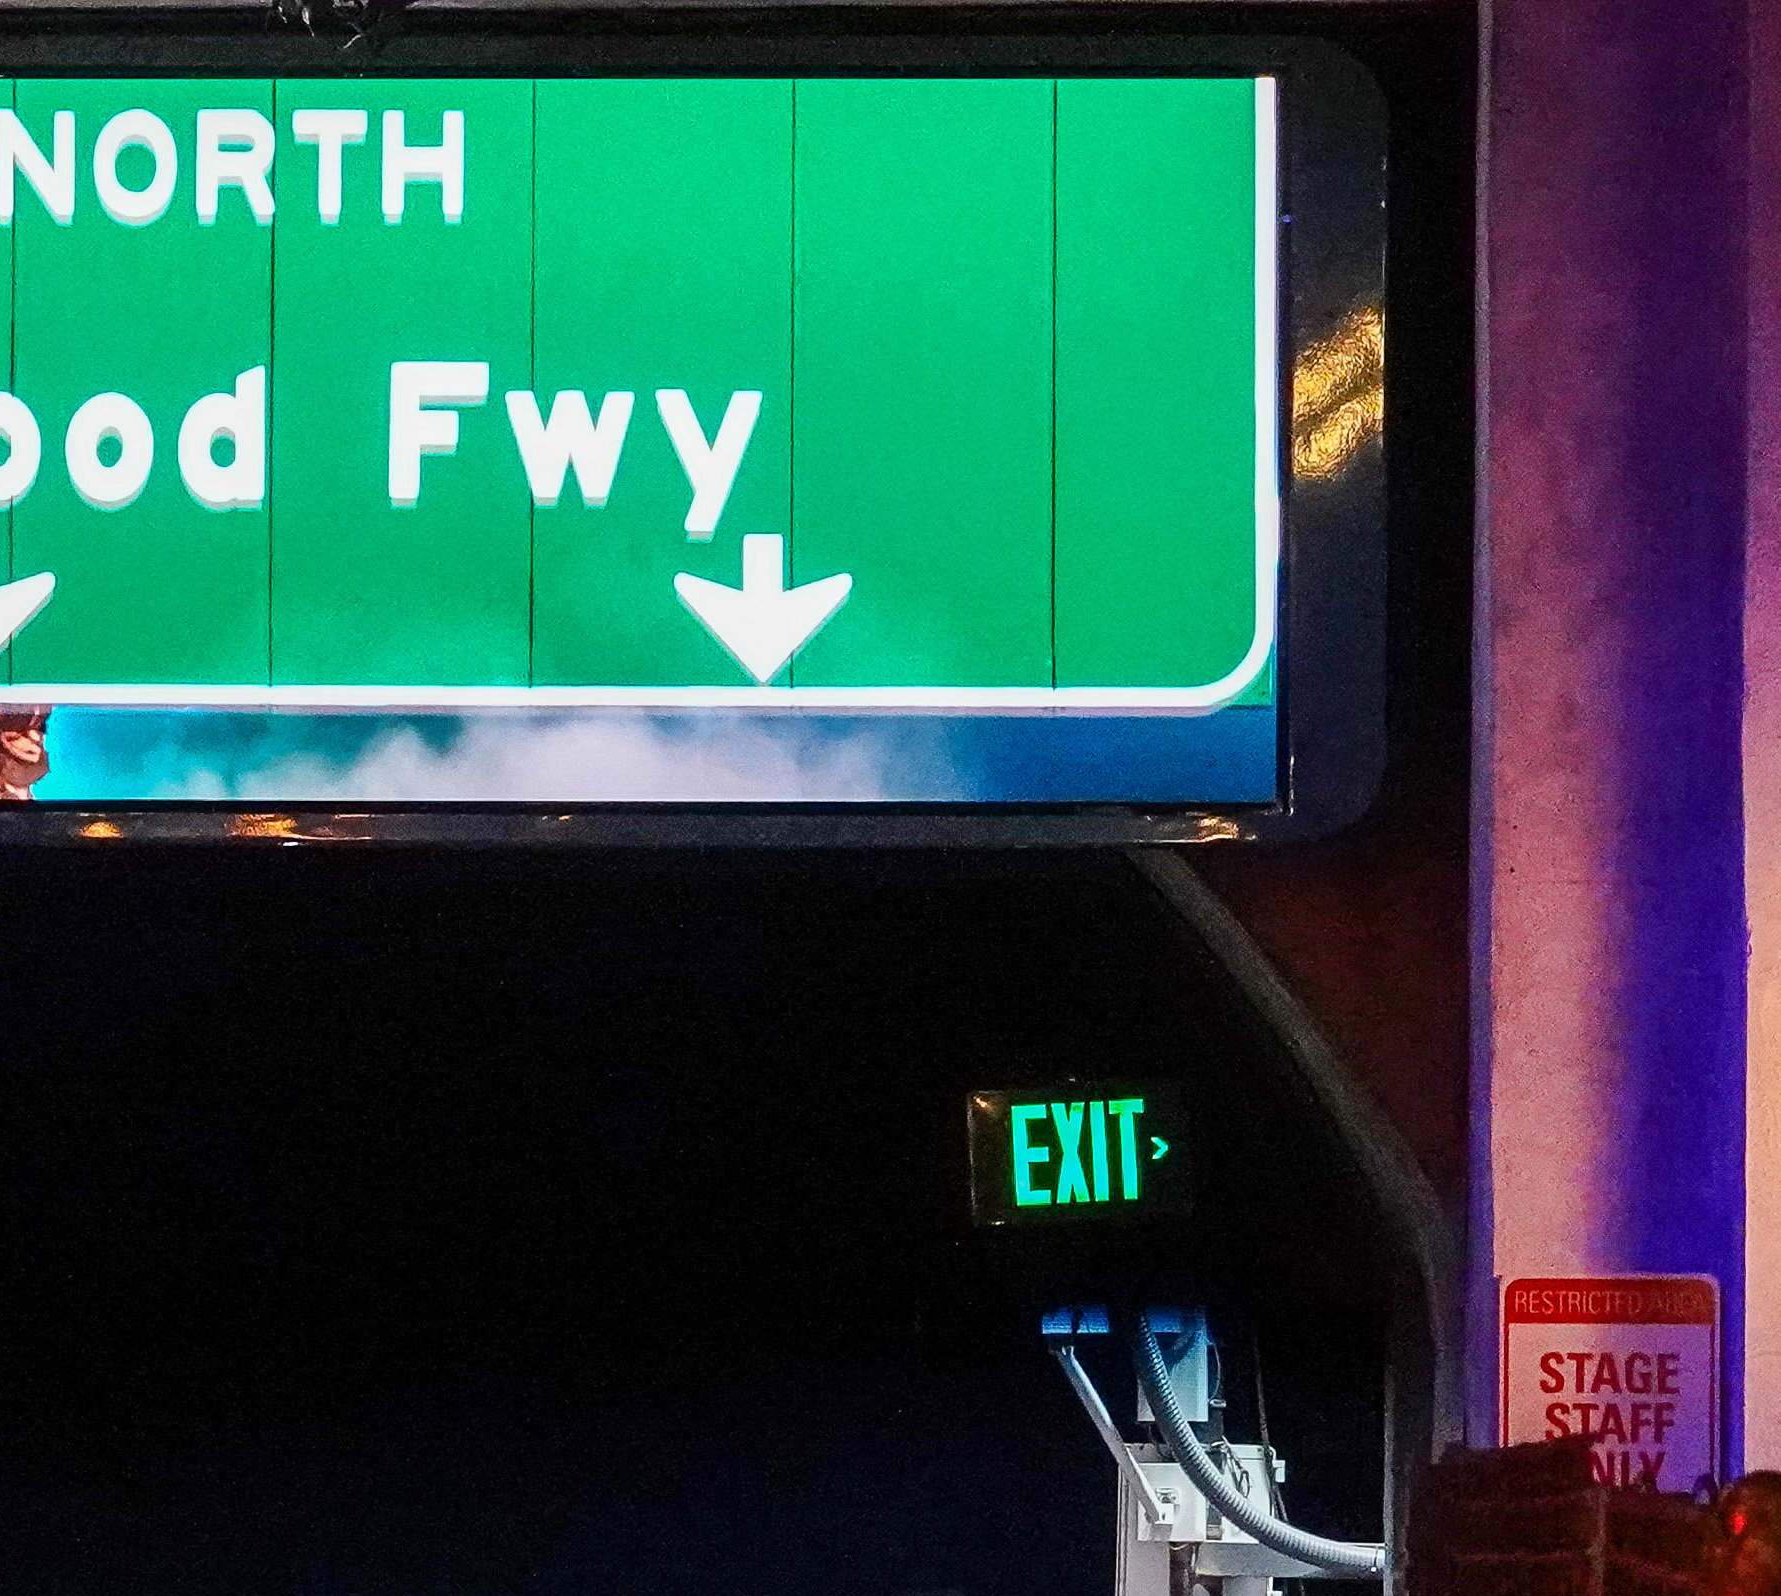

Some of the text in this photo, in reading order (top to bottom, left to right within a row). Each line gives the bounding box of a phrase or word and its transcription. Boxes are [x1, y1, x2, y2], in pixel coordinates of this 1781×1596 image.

[388, 360, 764, 542] Fwy
[1011, 1098, 1144, 1207] EXIT
[1539, 1351, 1681, 1395] STAGE
[1544, 1401, 1676, 1445] STAFF
[1592, 1450, 1667, 1488] NLY
